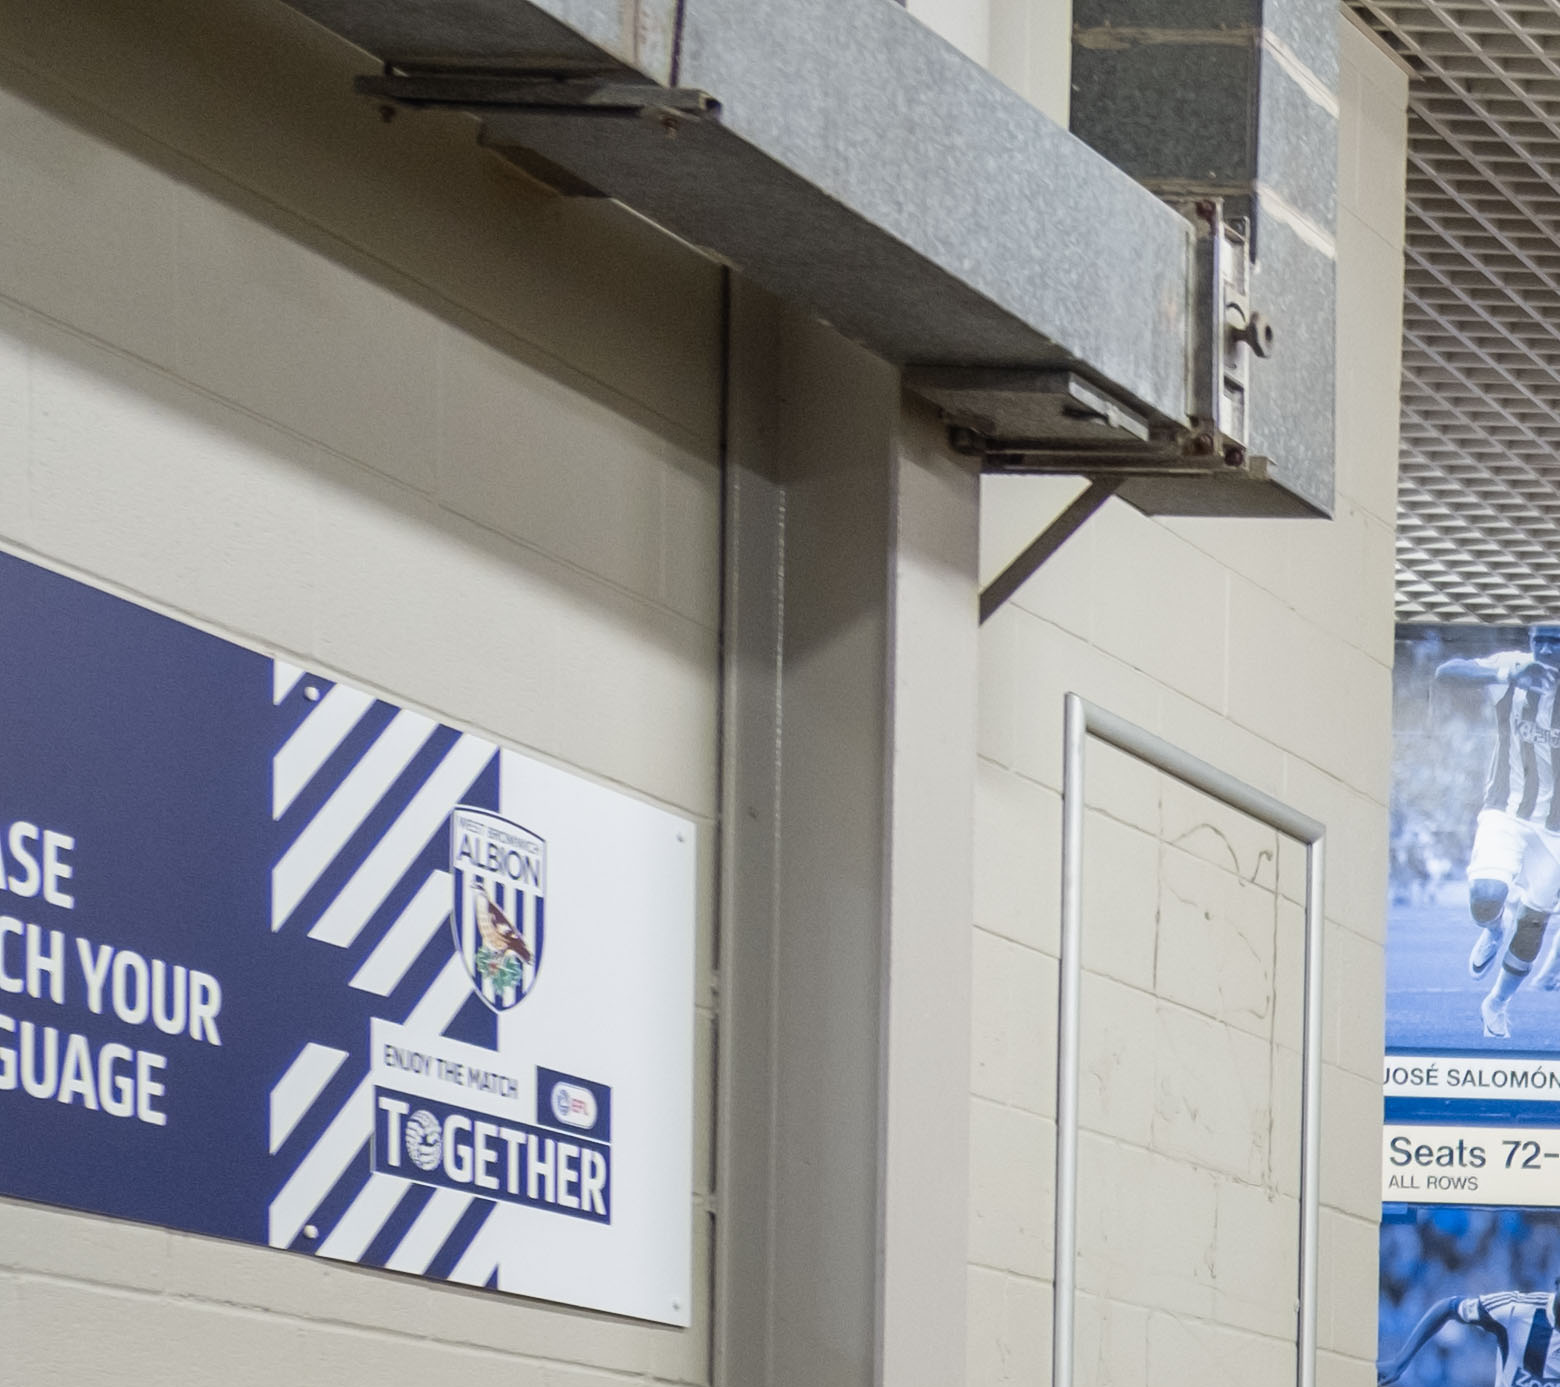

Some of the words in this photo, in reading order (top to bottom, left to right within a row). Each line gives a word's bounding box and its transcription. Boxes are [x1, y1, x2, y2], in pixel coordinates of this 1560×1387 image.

[456, 834, 540, 888] ALBION
[76, 937, 223, 1047] YOUR
[383, 1043, 431, 1077] ENJOY
[436, 1058, 465, 1086] THE
[468, 1066, 519, 1100] MATCH
[1389, 1136, 1487, 1168] Seats
[1388, 1174, 1420, 1190] ALL
[1426, 1175, 1479, 1191] ROWS
